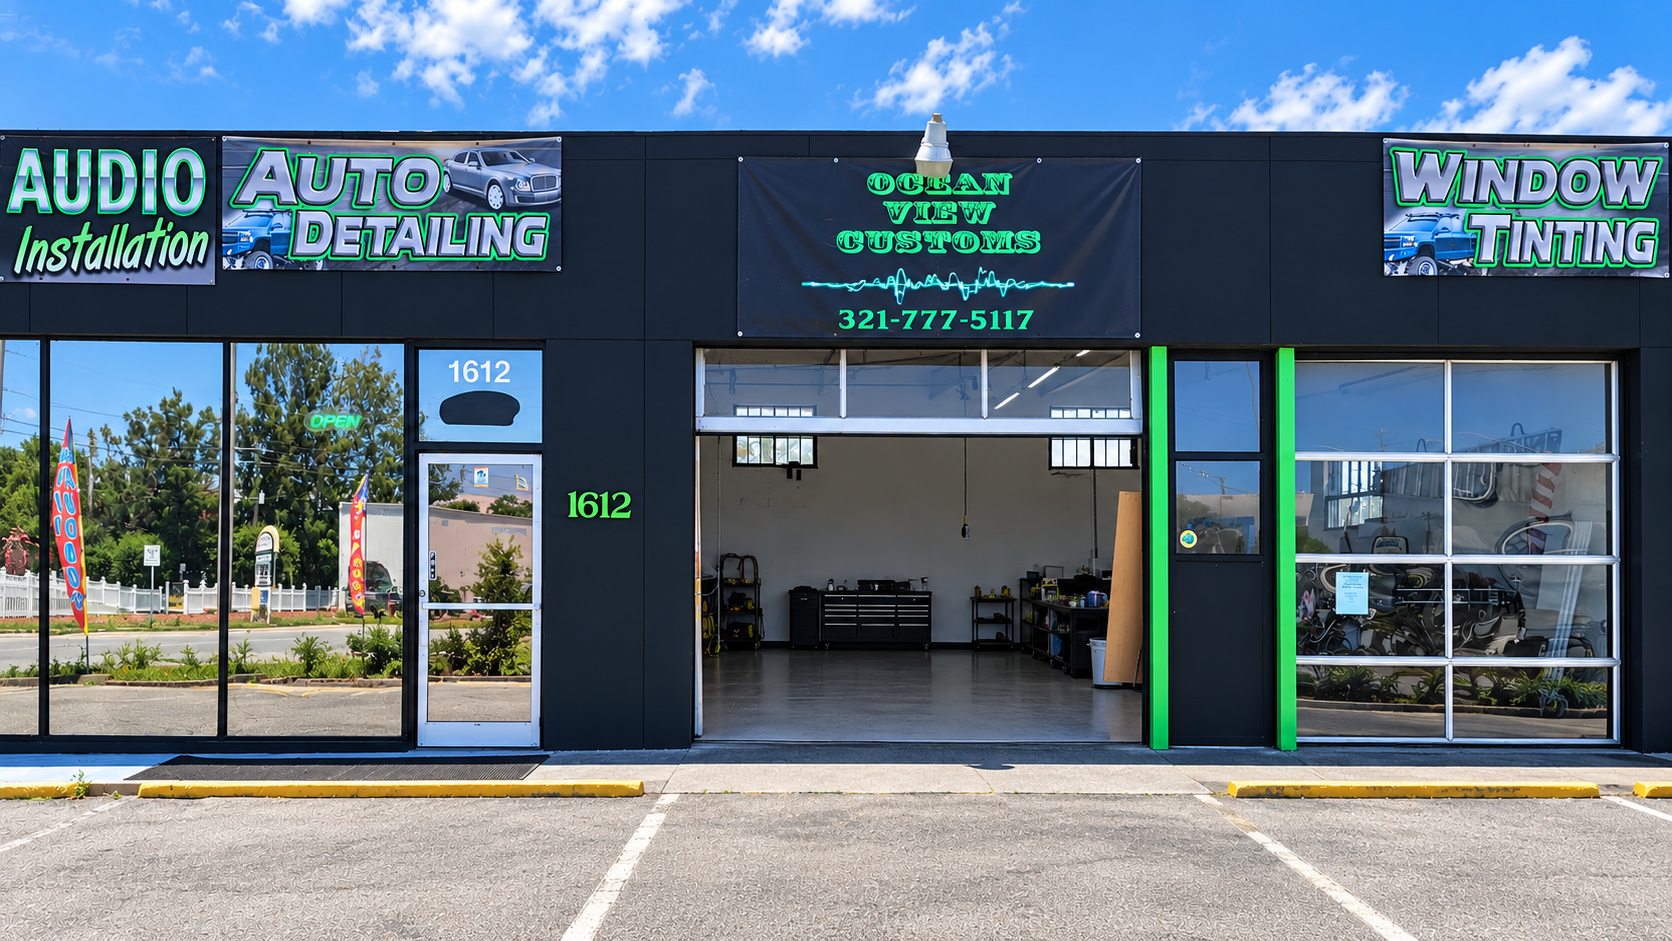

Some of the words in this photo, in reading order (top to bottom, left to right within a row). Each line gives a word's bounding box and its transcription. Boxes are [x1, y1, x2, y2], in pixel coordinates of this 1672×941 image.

[7, 147, 206, 216] AUDIO
[230, 147, 444, 210] AUTO
[866, 171, 1013, 196] OCEAN
[1389, 147, 1663, 209] WINDOW
[882, 201, 996, 225] VIEW
[13, 217, 209, 274] Installation
[290, 210, 550, 261] DETAILING
[836, 230, 1041, 255] CUSTOMS
[1464, 210, 1659, 268] TINTING
[838, 309, 1034, 331] 321-777-5117
[448, 360, 511, 383] 1612
[309, 414, 362, 429] OPEN
[567, 490, 632, 519] 1612
